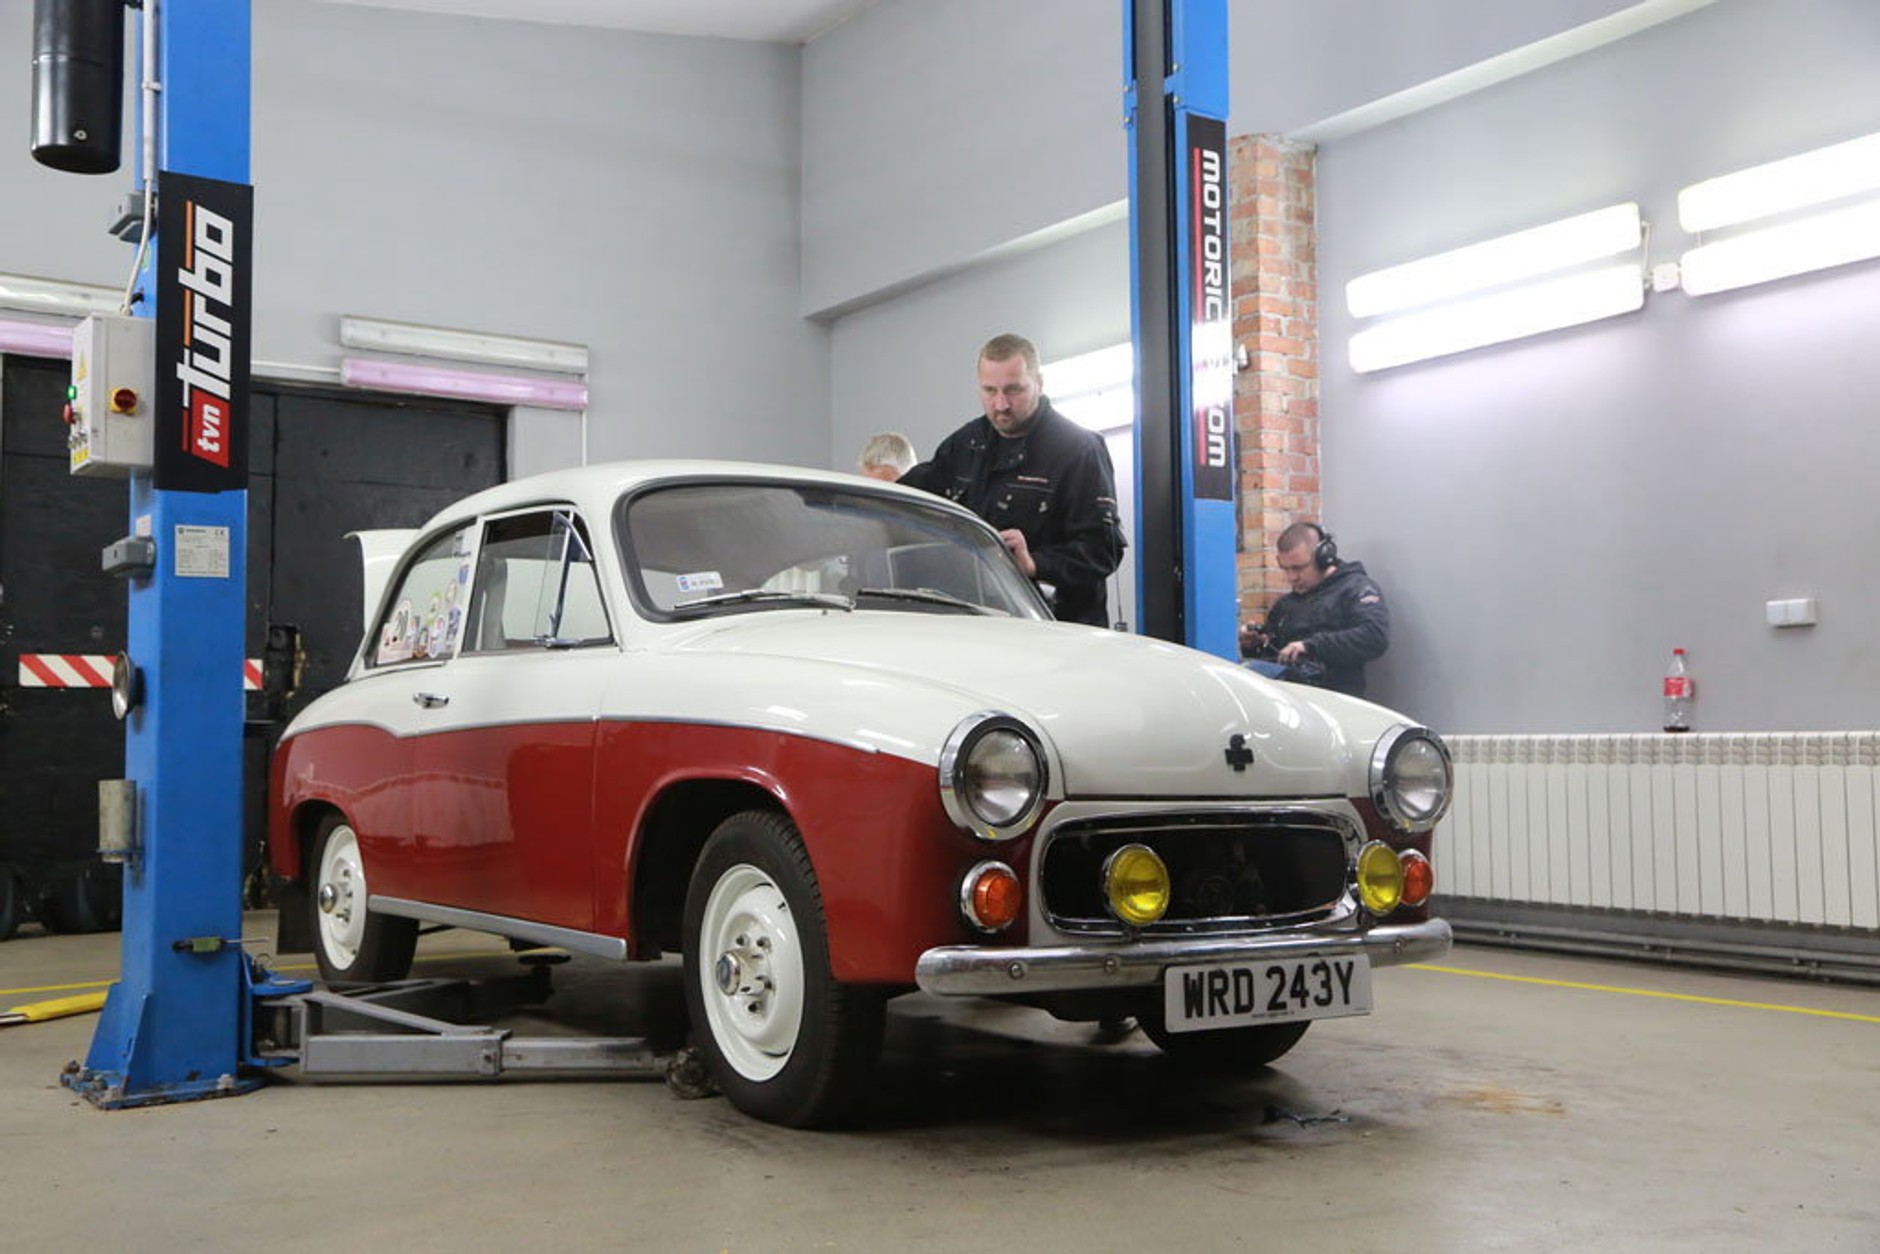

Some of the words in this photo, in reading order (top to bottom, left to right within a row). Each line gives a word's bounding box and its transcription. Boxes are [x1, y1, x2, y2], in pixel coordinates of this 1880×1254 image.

[176, 204, 233, 408] turbo
[1202, 149, 1226, 468] MOTORICOM
[198, 404, 221, 453] tvn
[1182, 968, 1255, 1018] WRD
[1265, 961, 1355, 1011] 243Y
